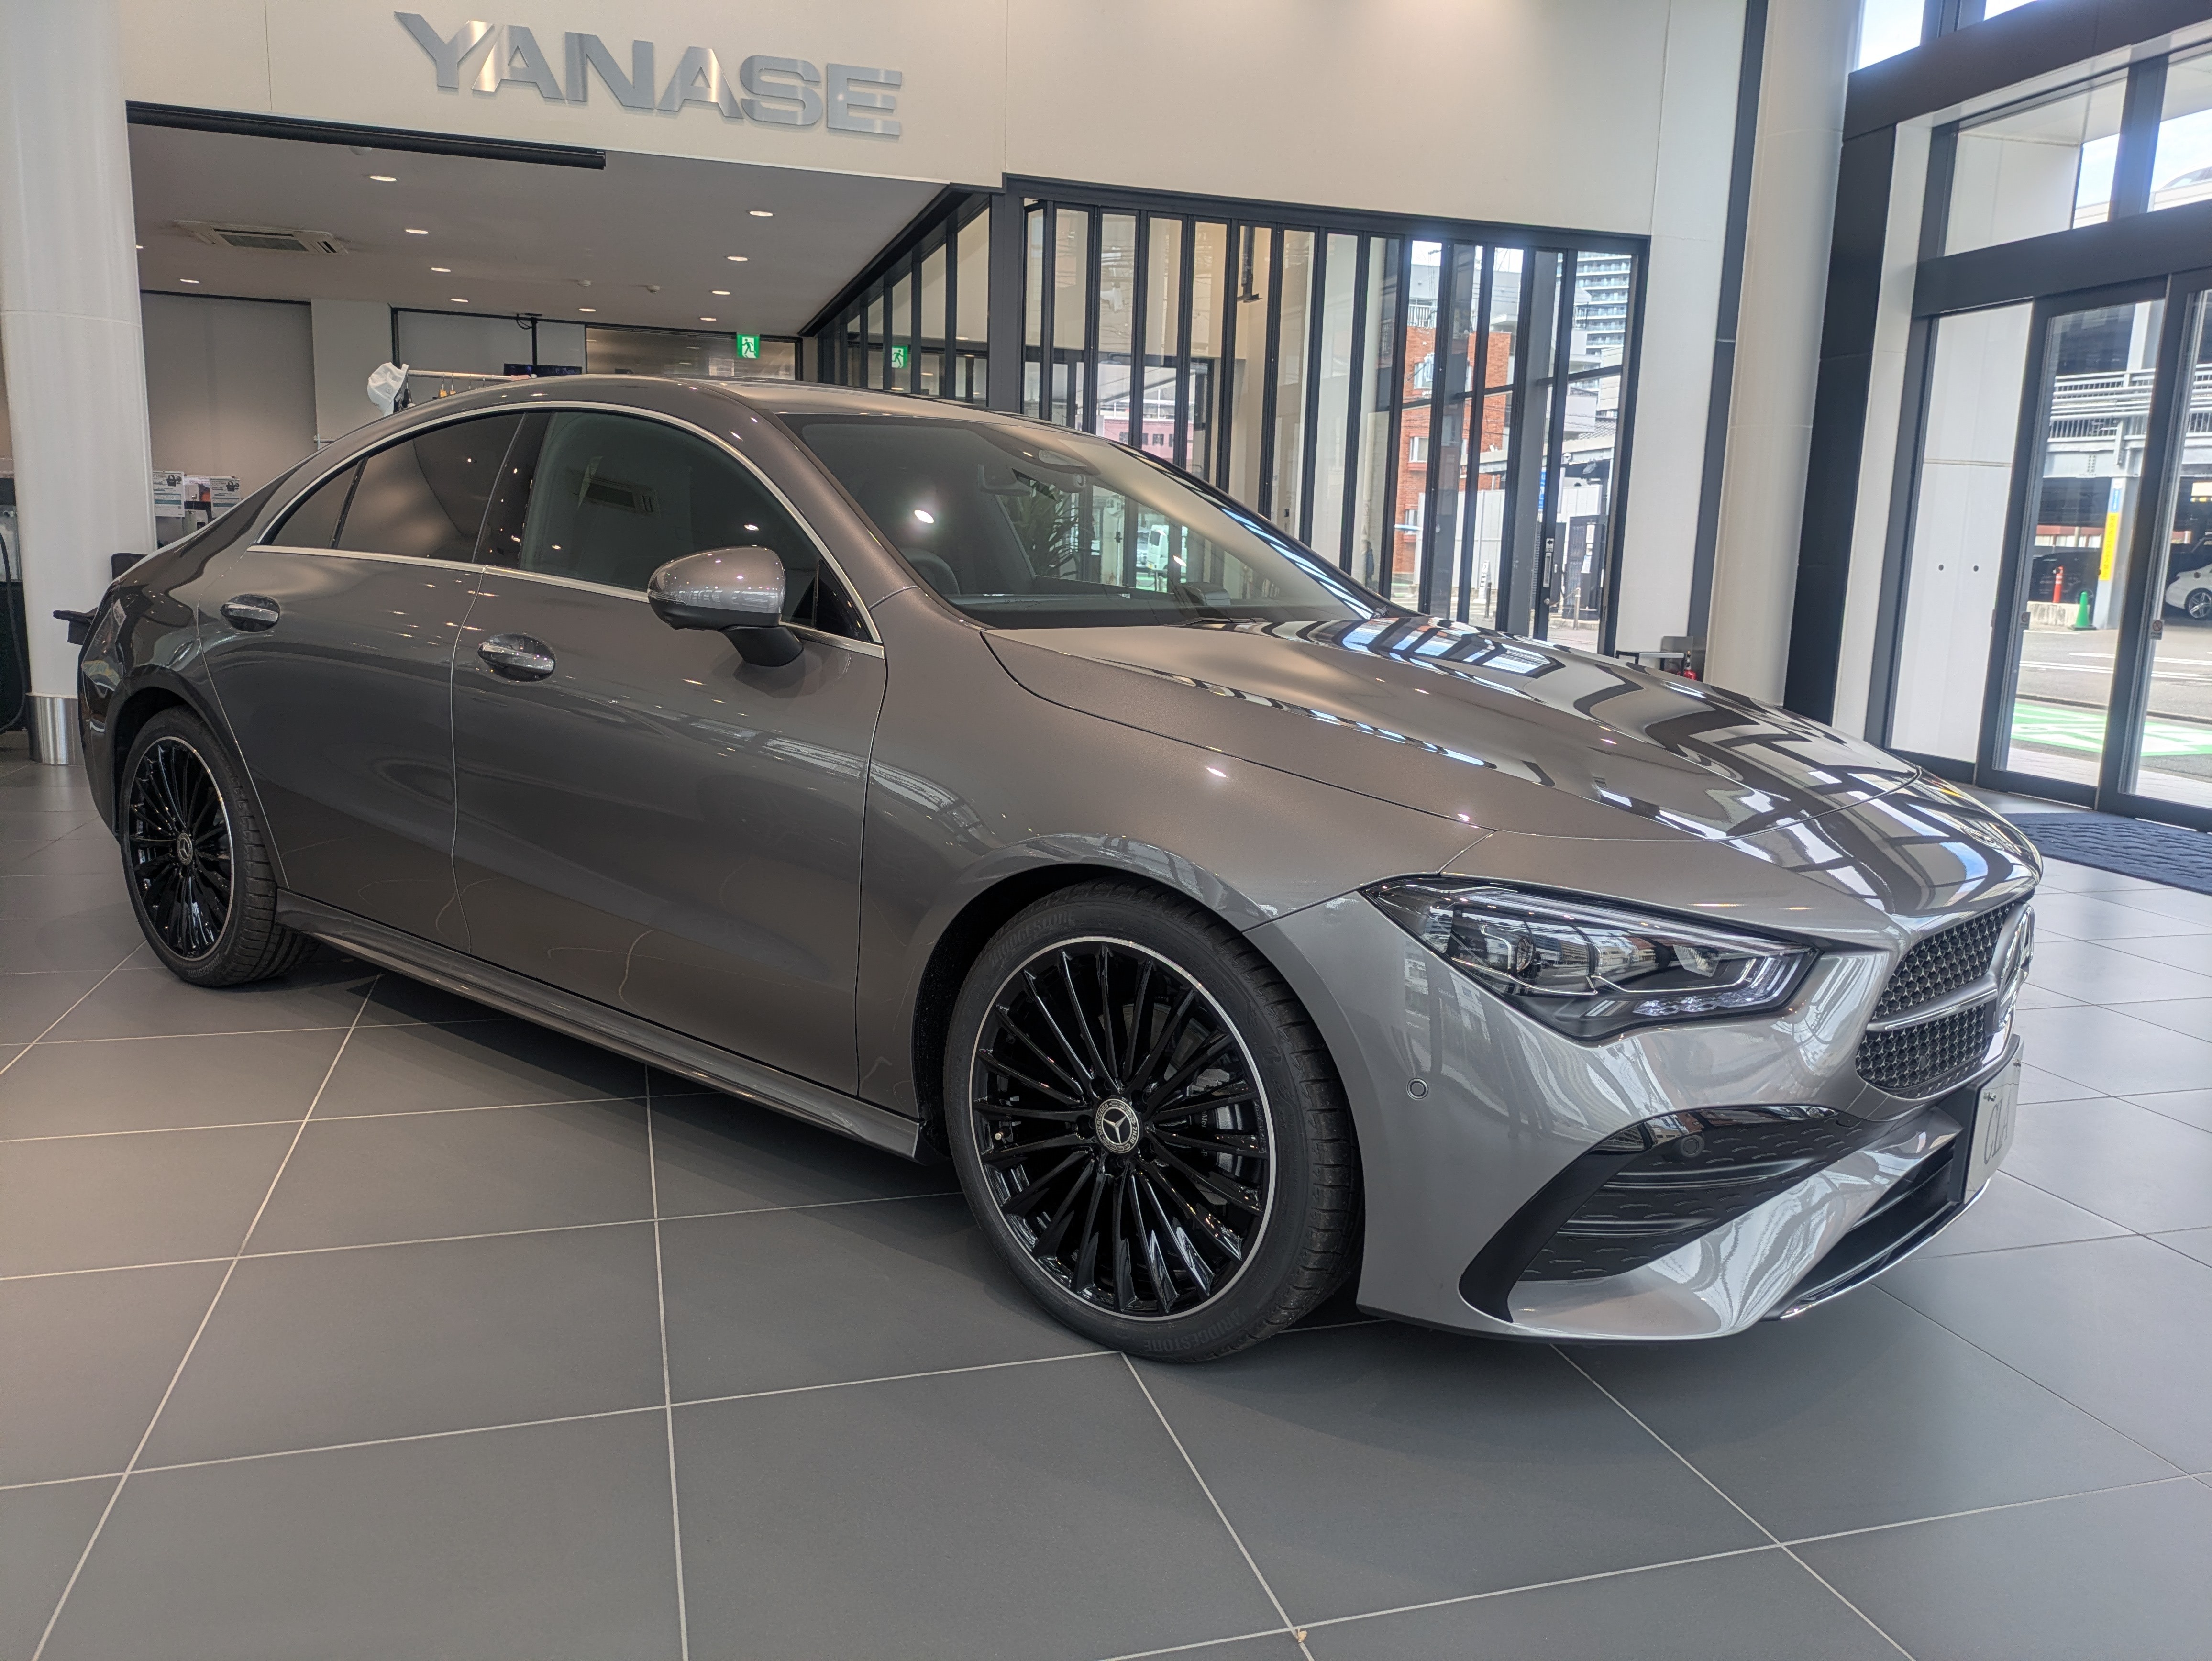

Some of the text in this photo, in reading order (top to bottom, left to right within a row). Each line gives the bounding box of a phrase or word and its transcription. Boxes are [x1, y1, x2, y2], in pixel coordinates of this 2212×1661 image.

[394, 11, 902, 136] YANASE
[988, 909, 1076, 965] BRIDGESTONE
[186, 953, 222, 978] BRIDGESTONE
[1096, 1103, 1109, 1135] MERCEDES
[1984, 1087, 2011, 1165] CLA
[1143, 1307, 1247, 1352] BRIDGESTONE
